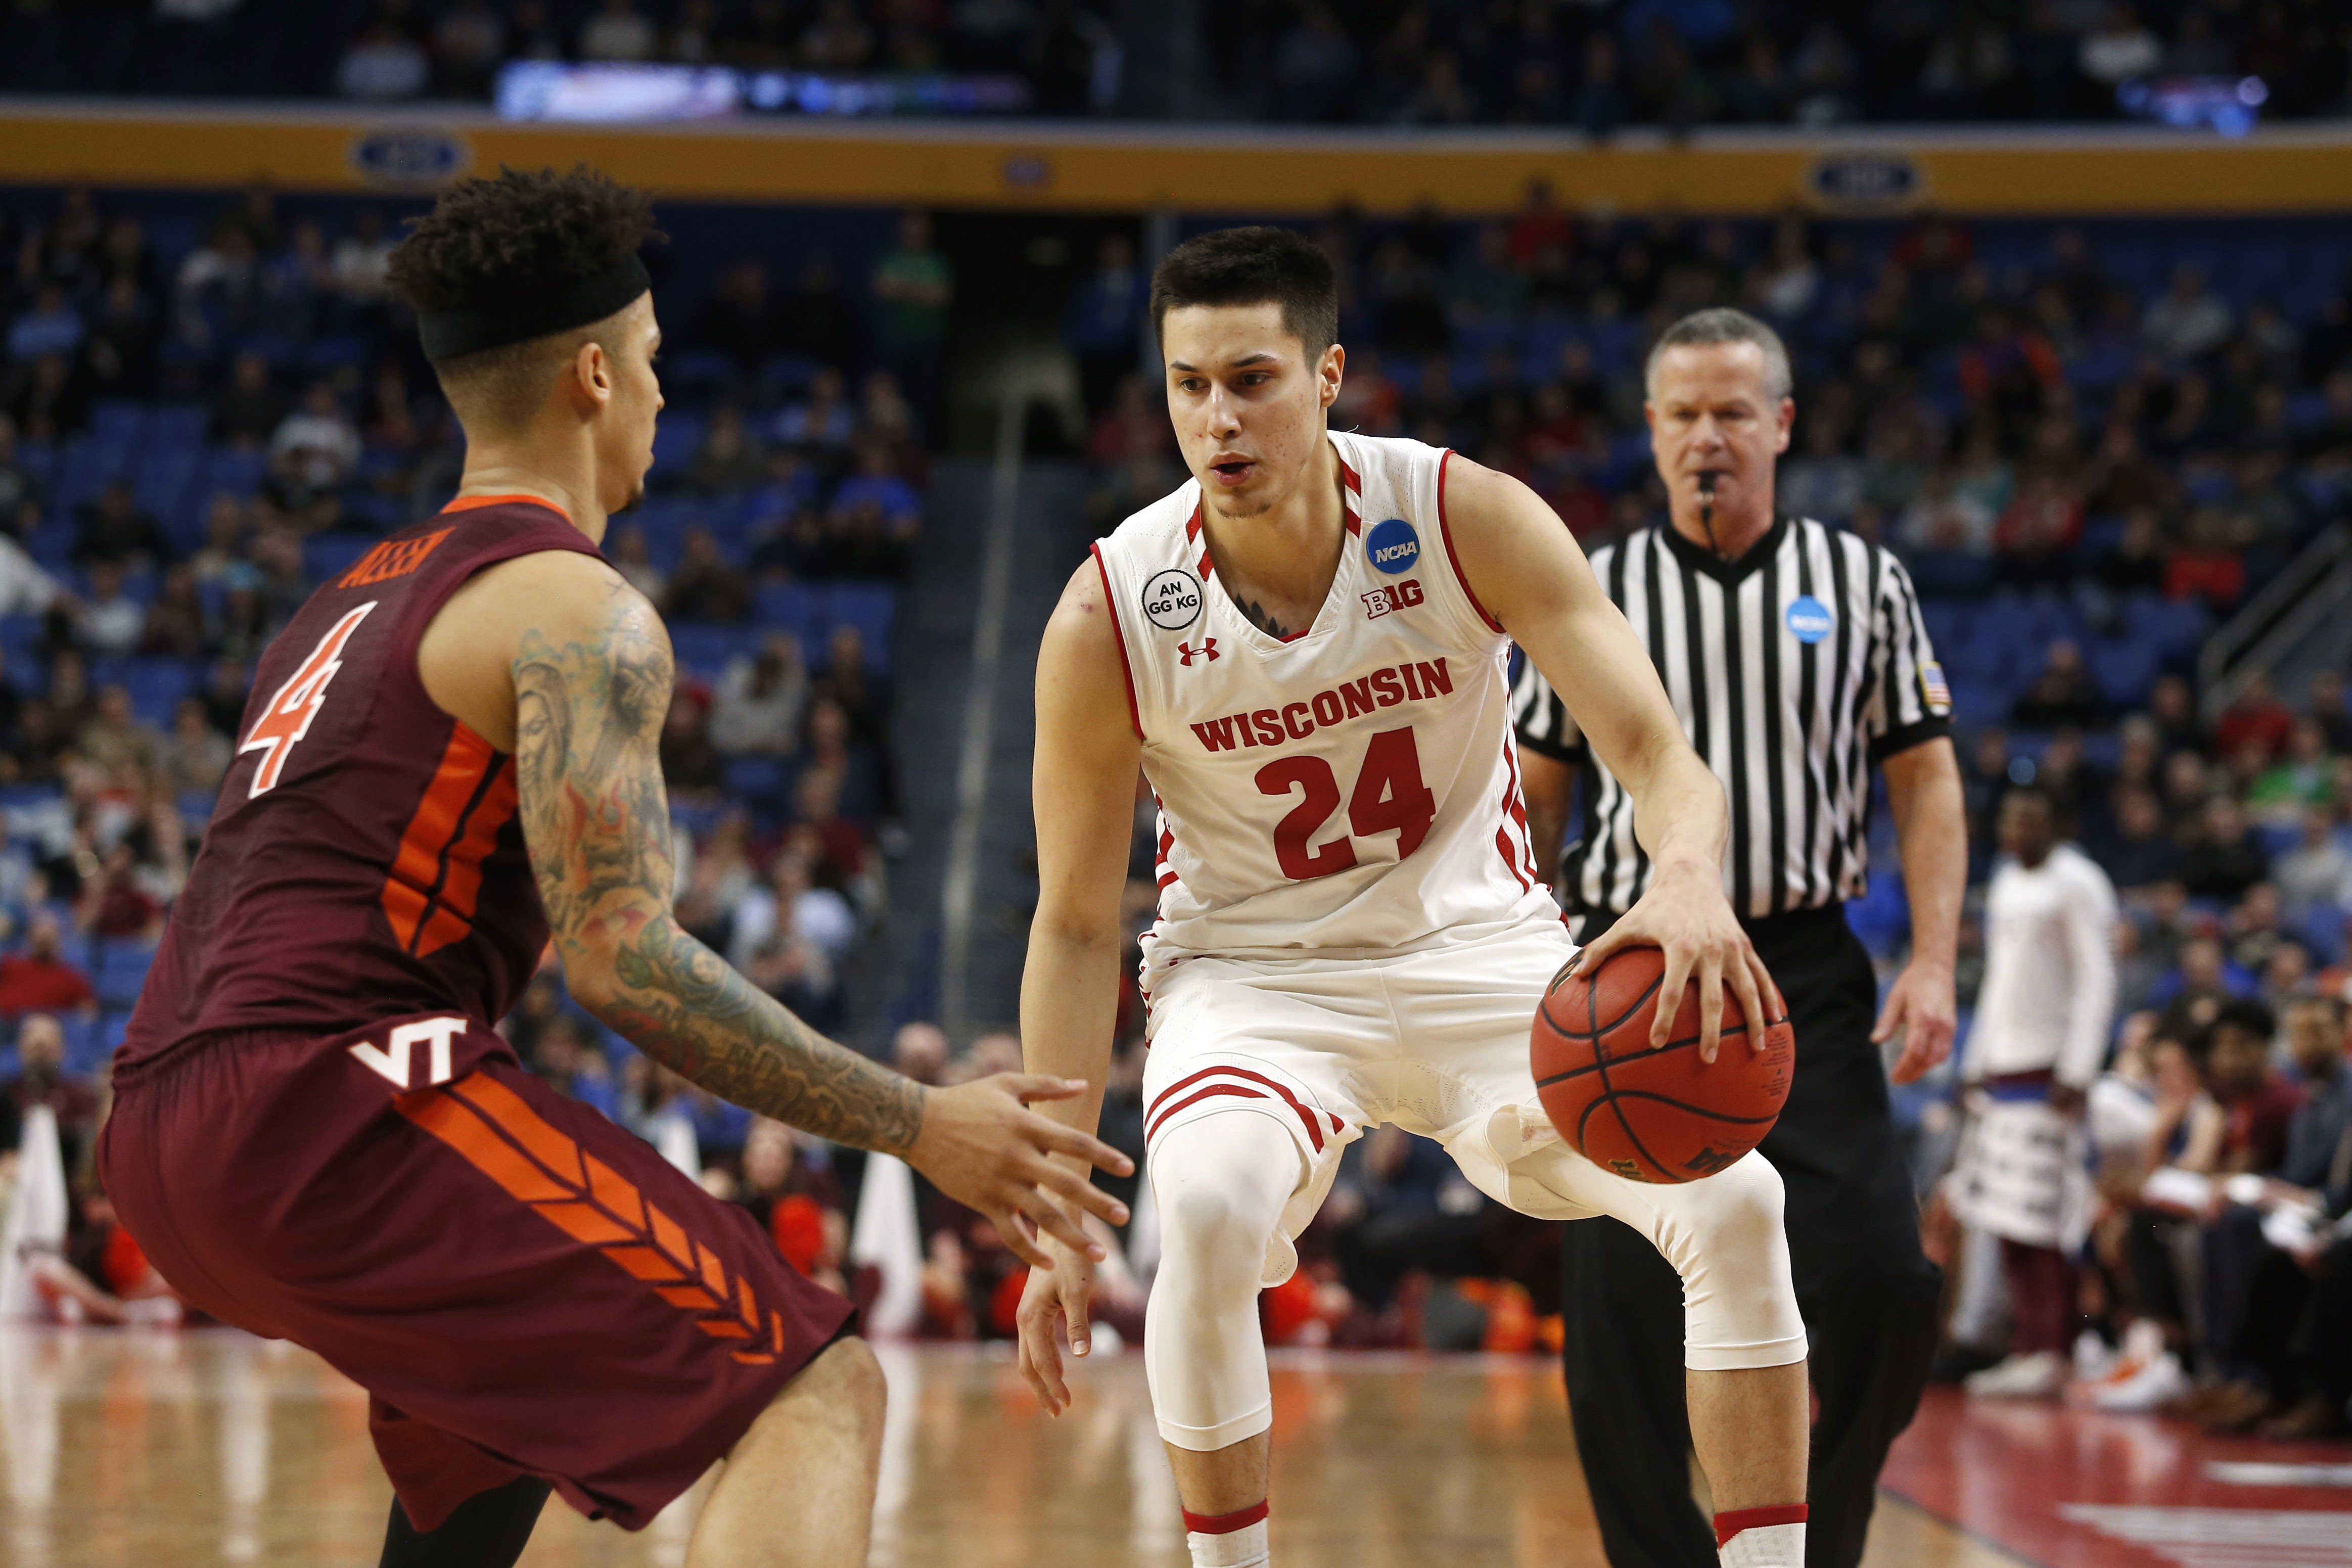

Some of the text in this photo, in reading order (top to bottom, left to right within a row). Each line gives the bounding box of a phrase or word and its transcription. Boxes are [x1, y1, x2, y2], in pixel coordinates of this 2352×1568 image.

[1375, 541, 1417, 563] NCAA
[1149, 594, 1197, 614] GG KG
[1160, 581, 1182, 597] AN
[239, 600, 379, 800] 4
[1189, 657, 1454, 752] WISCONSIN
[1254, 725, 1437, 880] 24
[348, 1016, 468, 1088] VT
